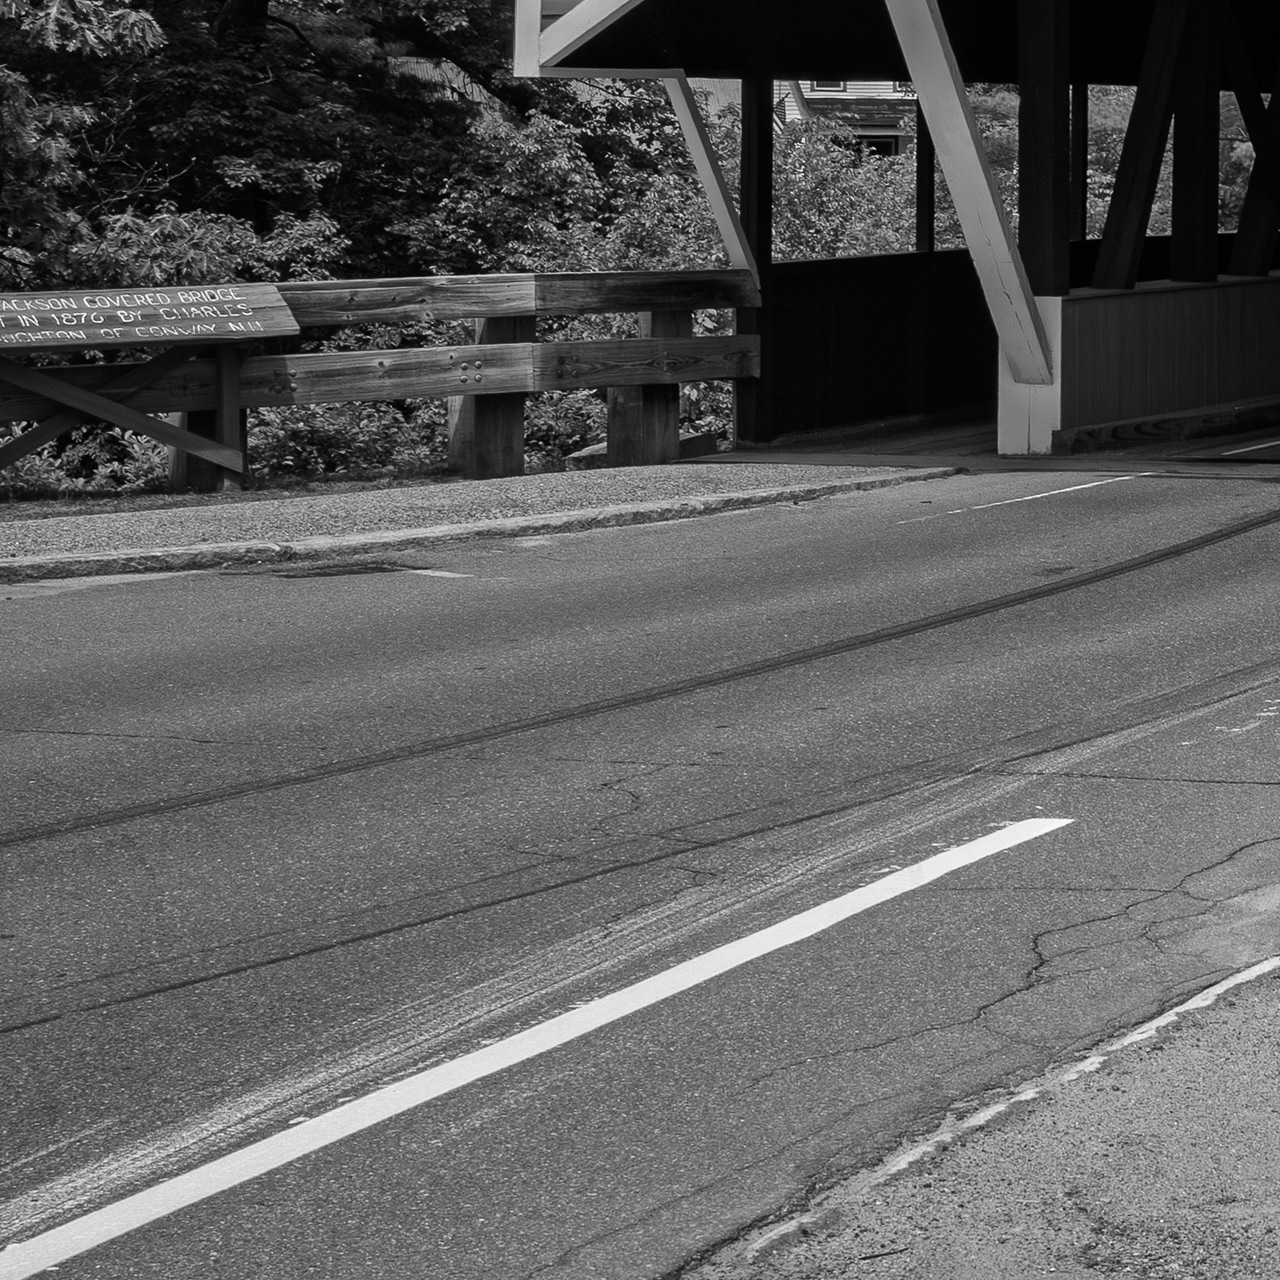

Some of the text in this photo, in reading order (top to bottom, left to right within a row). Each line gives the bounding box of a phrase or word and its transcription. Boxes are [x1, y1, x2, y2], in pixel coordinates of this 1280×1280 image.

[0, 287, 247, 311] ACKSON COVERED BRIDGE
[17, 314, 40, 327] IN
[50, 312, 104, 325] 1876
[117, 310, 142, 323] BY
[159, 303, 253, 320] CHARLES
[100, 327, 124, 339] OF
[135, 323, 216, 338] CONWAY
